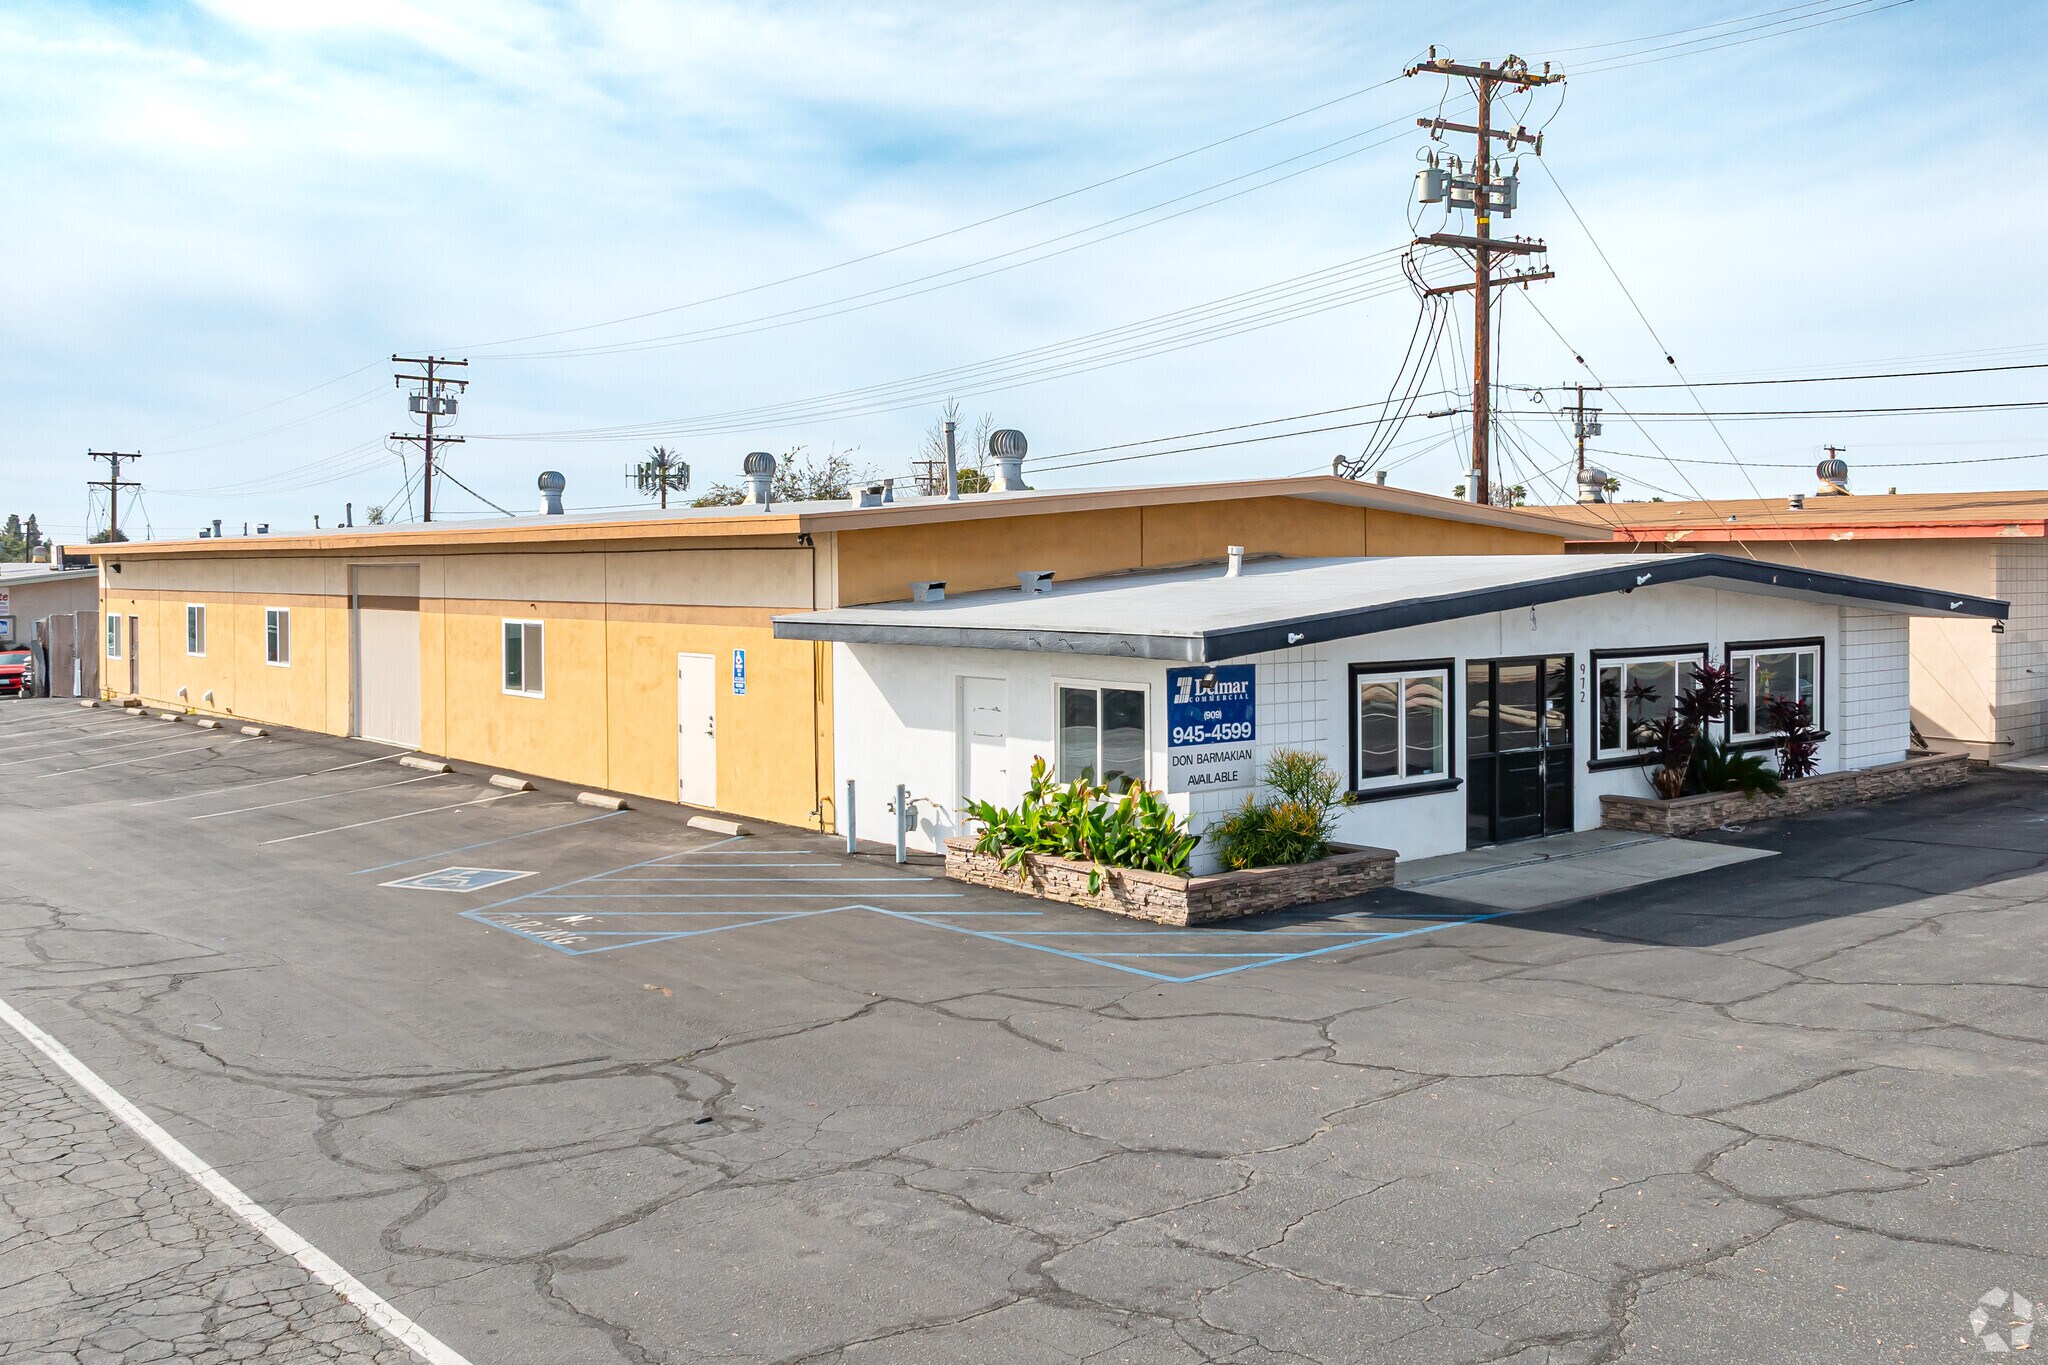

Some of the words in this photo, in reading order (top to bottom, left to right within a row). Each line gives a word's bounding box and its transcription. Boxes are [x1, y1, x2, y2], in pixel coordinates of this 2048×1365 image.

[1189, 694, 1249, 703] COMMERCIAL
[1203, 710, 1222, 721] (909)
[1172, 721, 1252, 744] 945-4599
[1172, 754, 1194, 767] DON
[1196, 749, 1252, 764] BARMAKIAN
[1187, 770, 1239, 786] AVAILABLE
